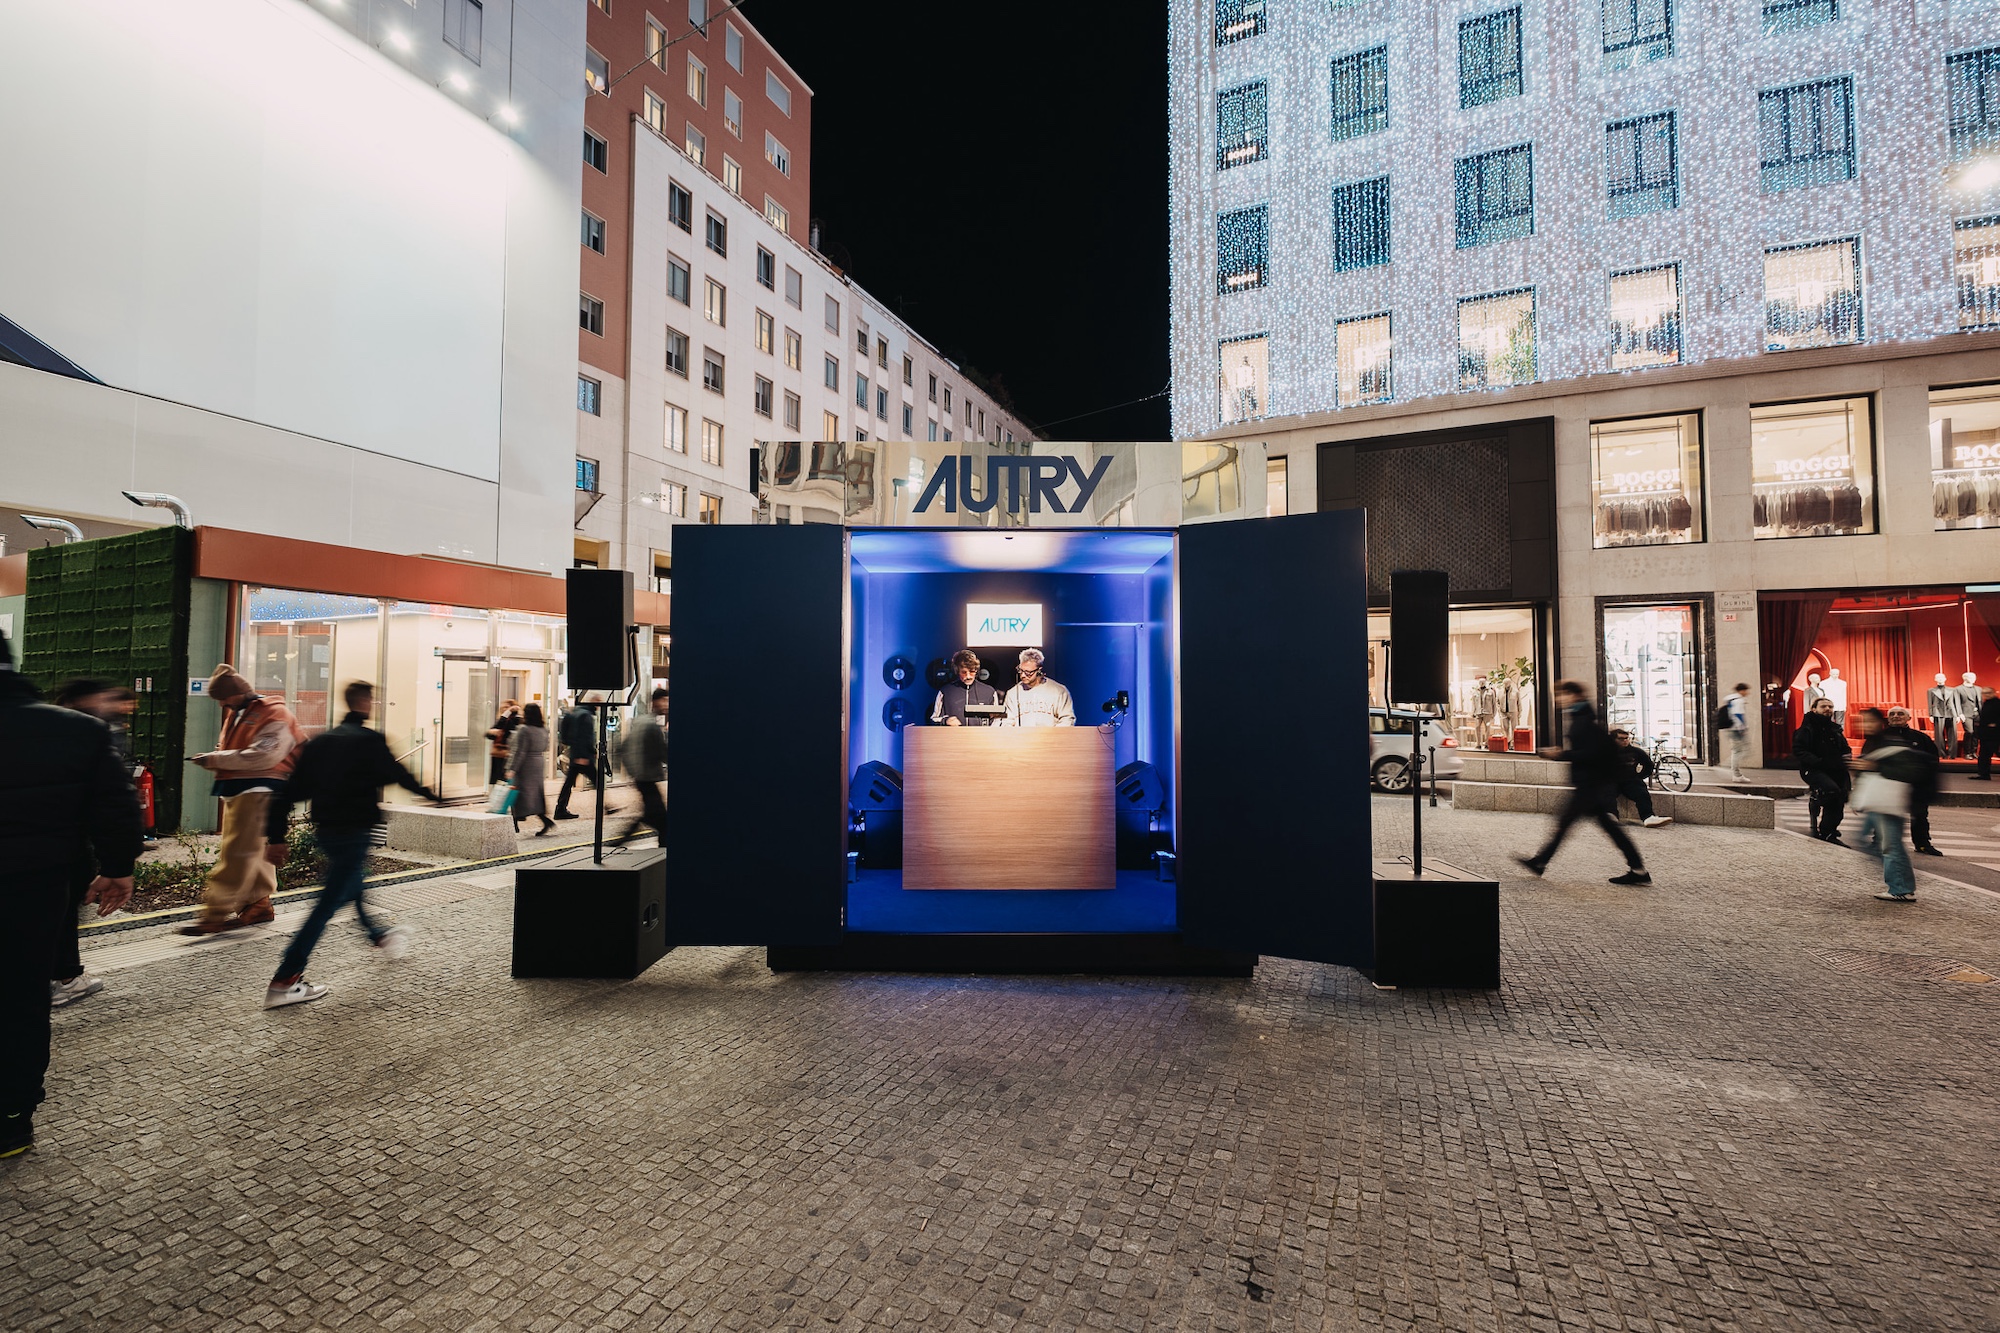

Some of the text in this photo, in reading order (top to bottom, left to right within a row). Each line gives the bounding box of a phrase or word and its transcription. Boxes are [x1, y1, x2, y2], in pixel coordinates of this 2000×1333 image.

[1774, 455, 1850, 474] BOGGI
[1612, 468, 1680, 487] BOGGI
[1782, 470, 1843, 481] MILANO
[912, 455, 1115, 513] AUTRY
[1619, 483, 1674, 493] MILANO
[979, 618, 1030, 632] AUTRY
